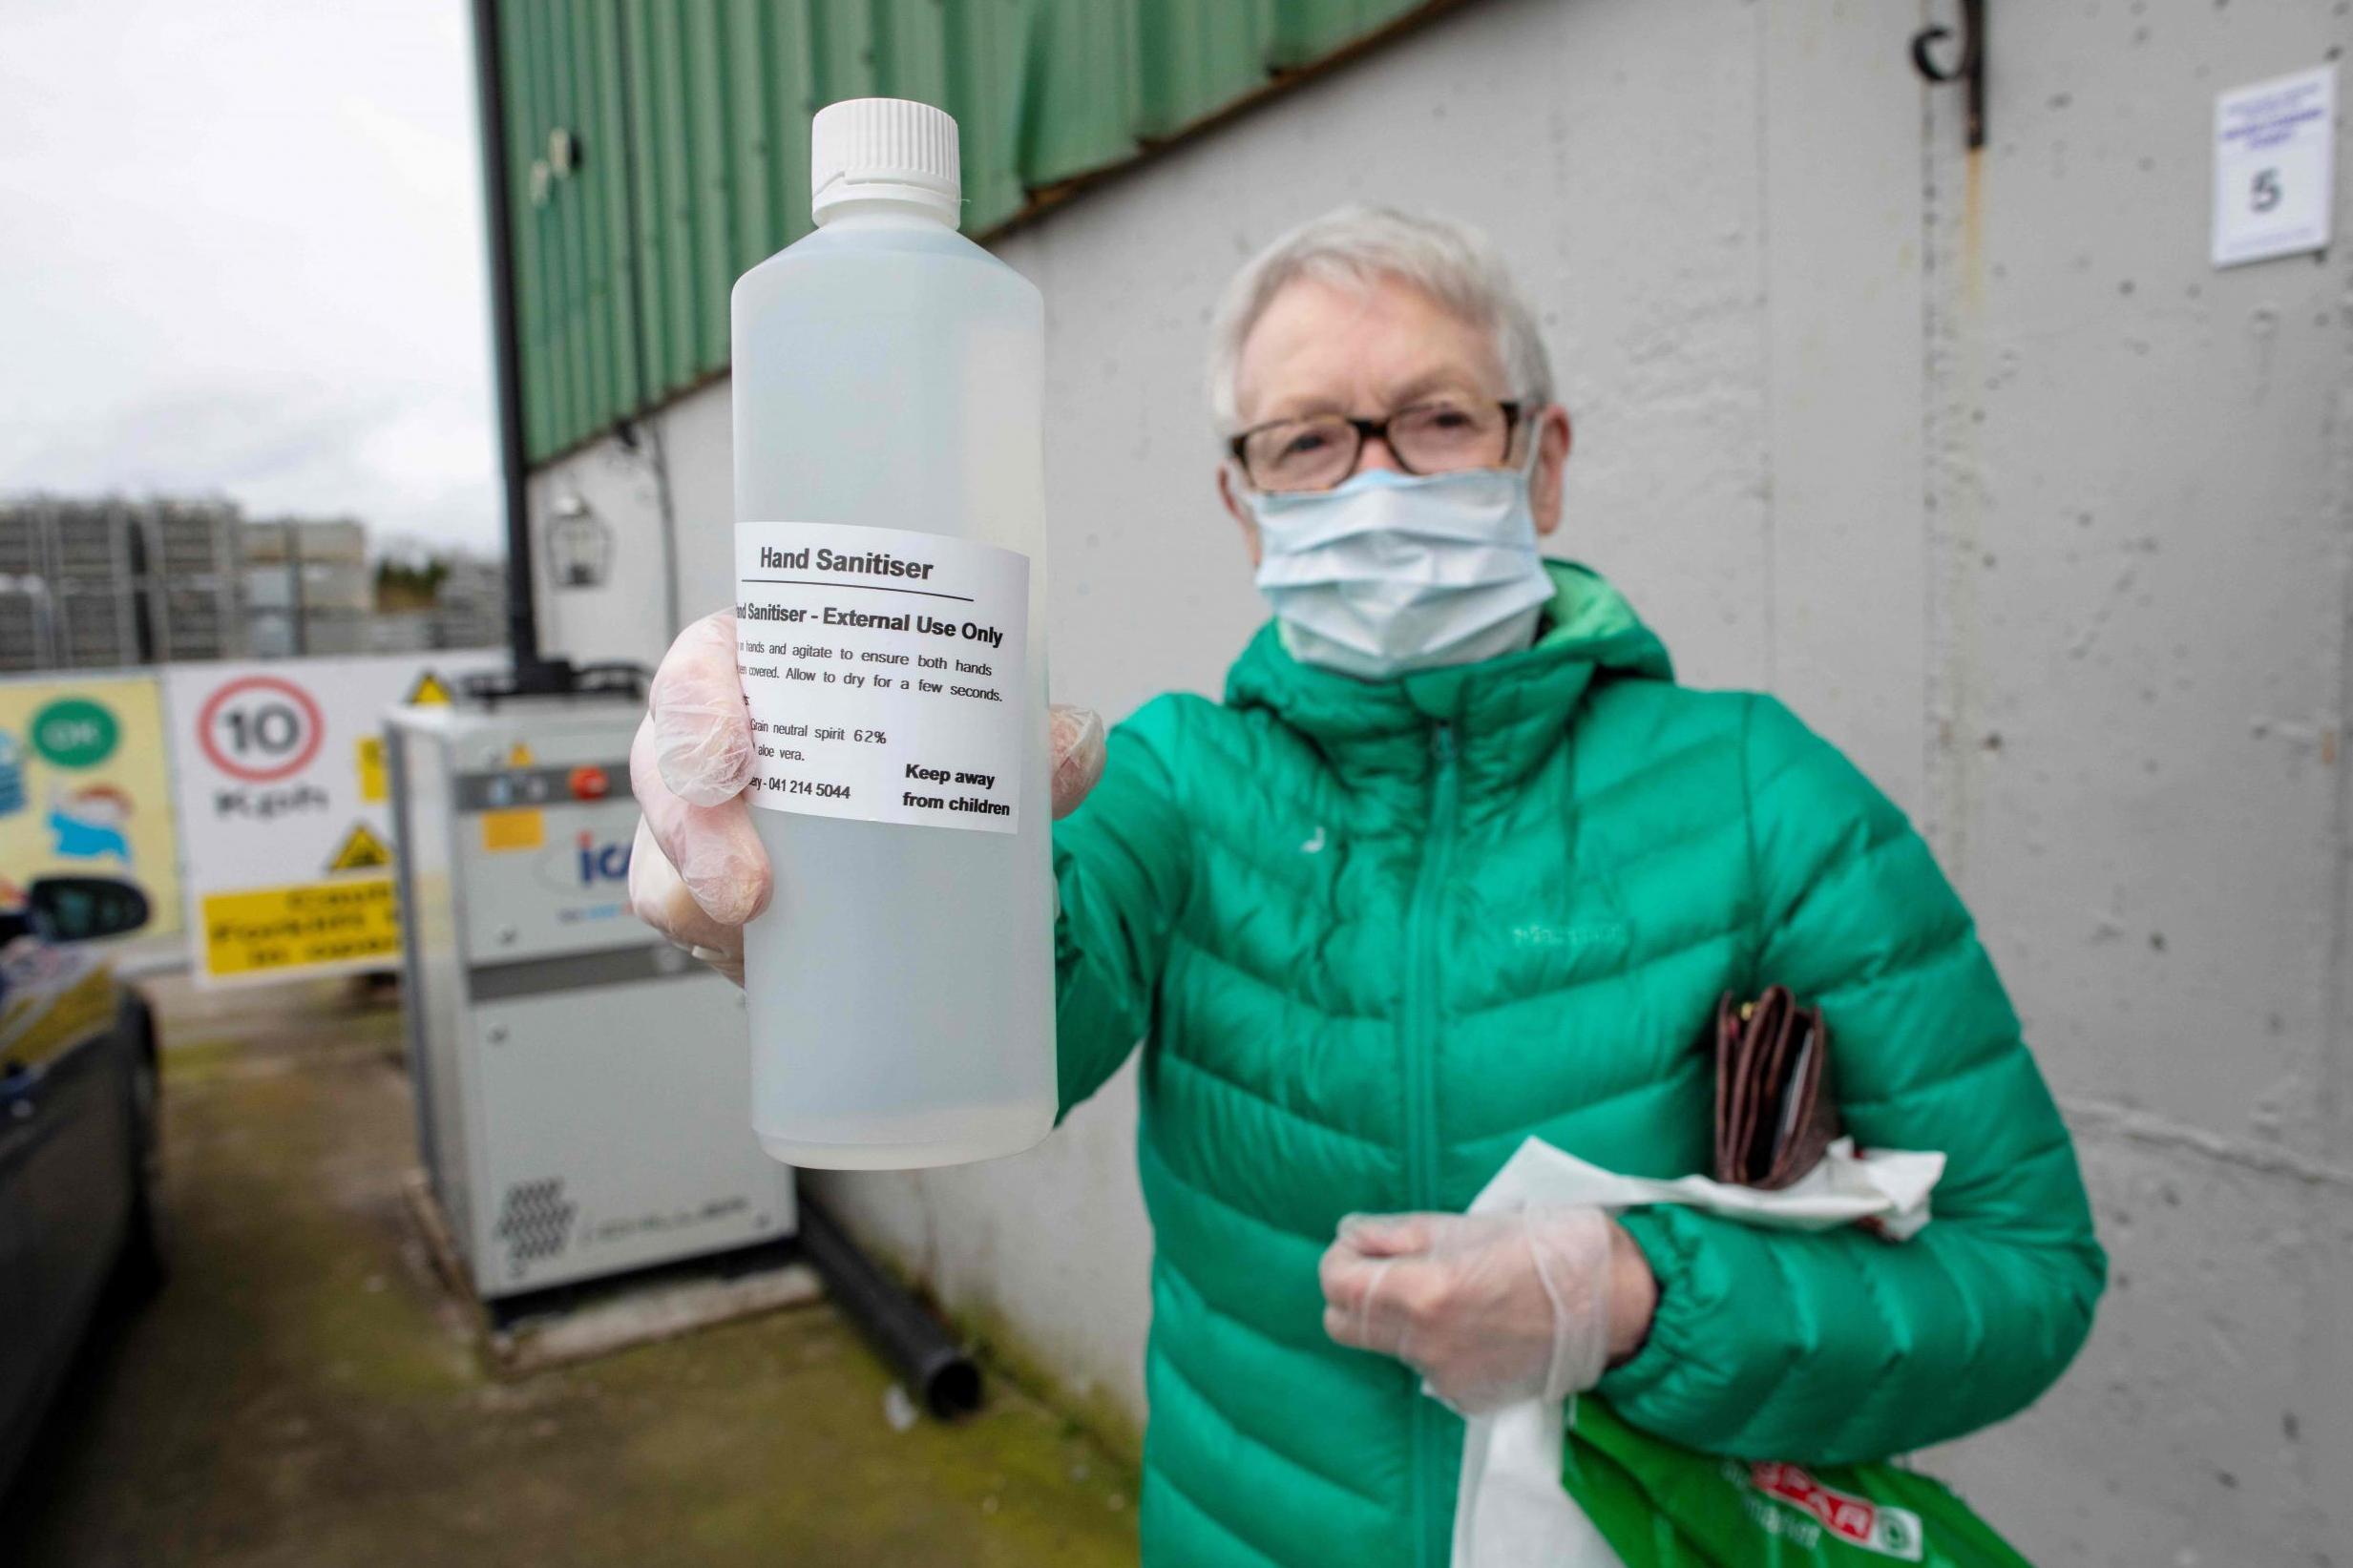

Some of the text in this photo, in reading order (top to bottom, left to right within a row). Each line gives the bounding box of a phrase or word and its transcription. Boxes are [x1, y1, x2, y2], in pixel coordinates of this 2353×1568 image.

[2248, 166, 2282, 214] 5
[760, 546, 935, 580] Hand Sanitiser
[736, 603, 746, 620] and
[747, 602, 808, 623] Sanitiser
[823, 606, 911, 632] External
[916, 615, 956, 637] Use
[961, 622, 1003, 648] Only
[746, 639, 765, 654] hands
[768, 642, 787, 656] and
[792, 644, 832, 659] agitate
[840, 648, 853, 660] to
[861, 651, 910, 666] ensure
[917, 655, 948, 670] both
[956, 659, 993, 677] hands
[748, 666, 780, 679] covered.
[786, 667, 816, 681] Allow
[823, 671, 836, 683] to
[843, 672, 866, 688] dry
[873, 674, 893, 688] for
[900, 679, 910, 690] a
[917, 679, 943, 693] few
[950, 684, 1003, 702] seconds.
[225, 704, 302, 758] 10
[750, 718, 887, 744] Grain neutral spirit 62%
[758, 744, 775, 758] aloe
[779, 749, 806, 762] vera.
[768, 777, 787, 792] 041
[789, 780, 812, 795] 214
[815, 783, 851, 800] 5044
[905, 763, 996, 790] Keep away
[902, 791, 1010, 816] from children
